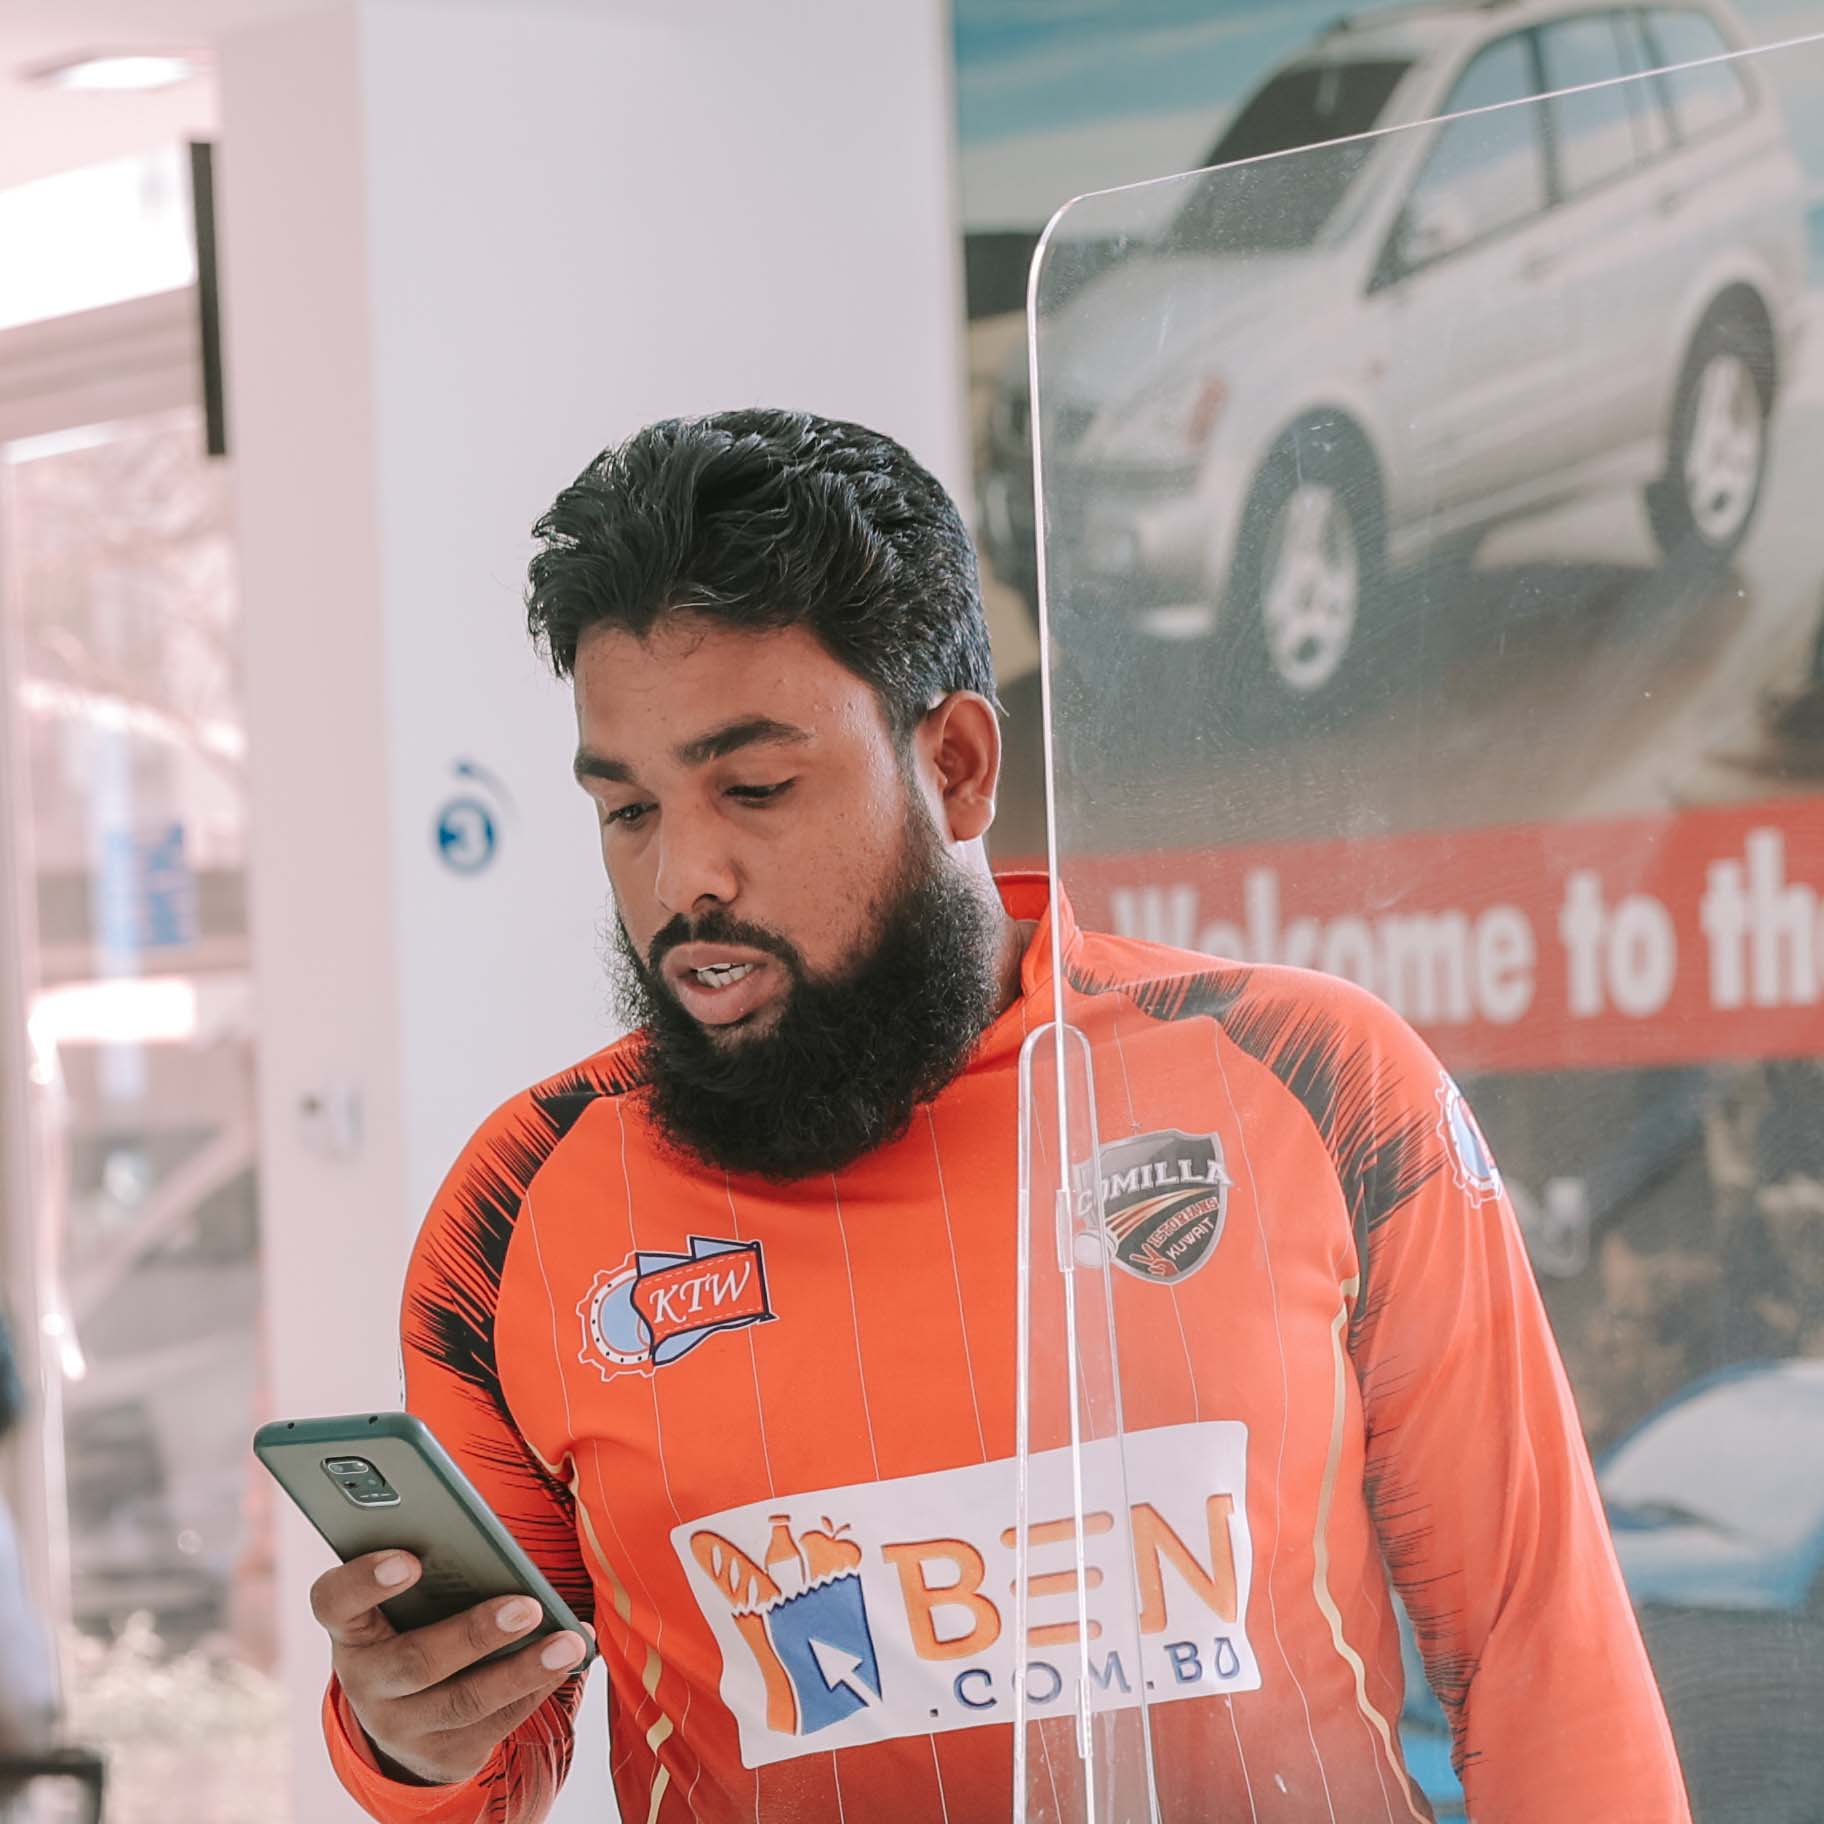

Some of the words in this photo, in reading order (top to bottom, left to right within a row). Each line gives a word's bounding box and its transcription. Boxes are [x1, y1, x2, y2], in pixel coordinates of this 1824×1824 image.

[1557, 869, 1676, 1018] to
[1166, 1217, 1214, 1260] KUWAIT
[649, 1261, 751, 1324] KTW
